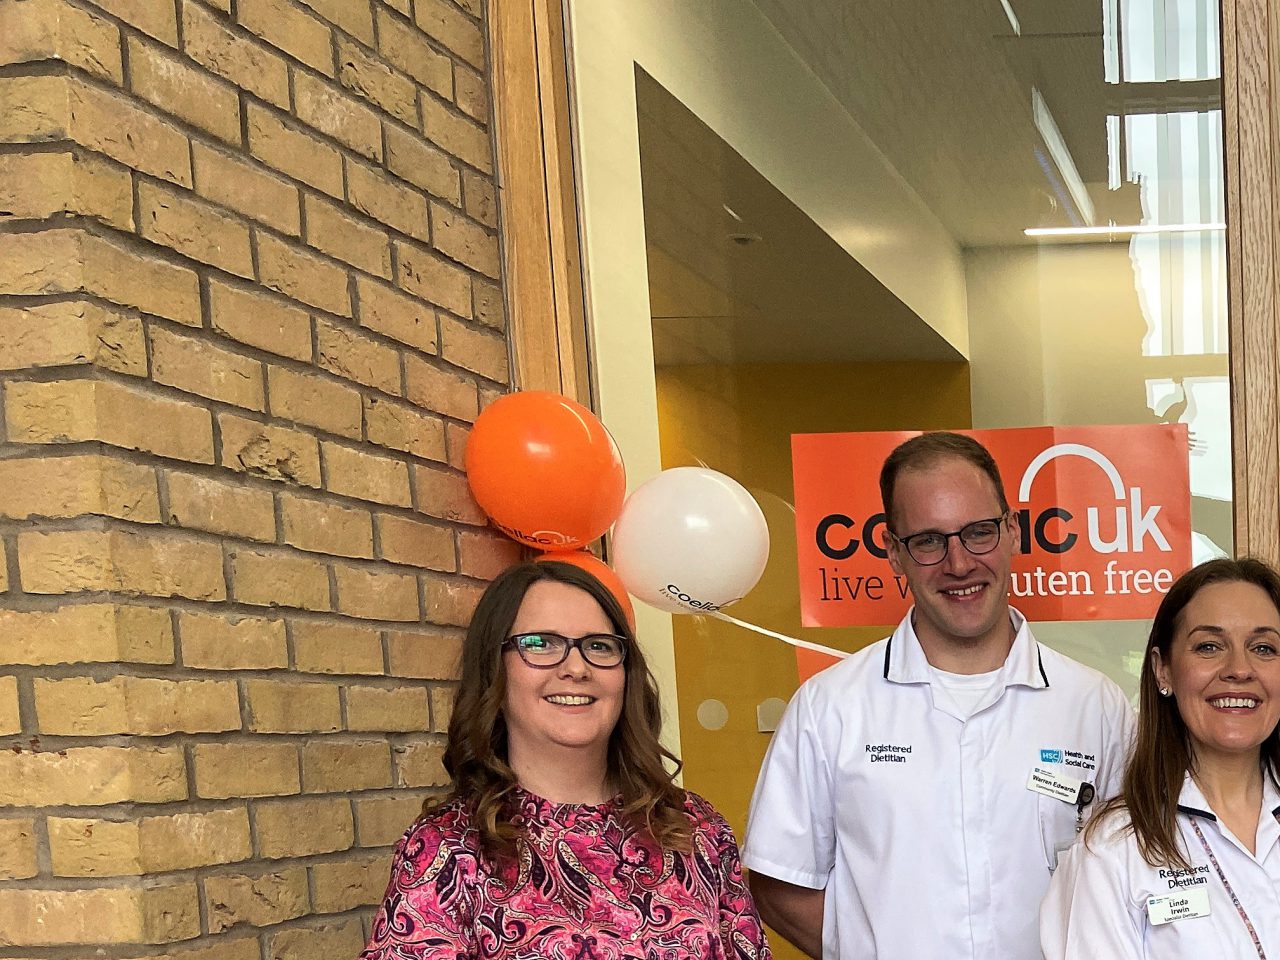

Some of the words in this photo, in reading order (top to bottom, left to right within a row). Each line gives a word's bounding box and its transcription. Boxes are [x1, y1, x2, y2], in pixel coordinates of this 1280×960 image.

[1087, 487, 1172, 552] uk
[818, 568, 884, 601] live
[1007, 567, 1094, 598] uten
[1104, 560, 1173, 595] free
[865, 744, 912, 753] Registered
[870, 754, 906, 763] Dietitian
[1042, 752, 1058, 760] HSC
[1065, 750, 1083, 759] Health
[1065, 759, 1081, 767] Social
[1082, 762, 1095, 770] Care
[1032, 775, 1052, 786] Warren
[1053, 781, 1076, 794] Edwards
[1168, 876, 1208, 889] Dietitian
[1169, 899, 1189, 908] Linda
[1171, 907, 1190, 915] Irwin
